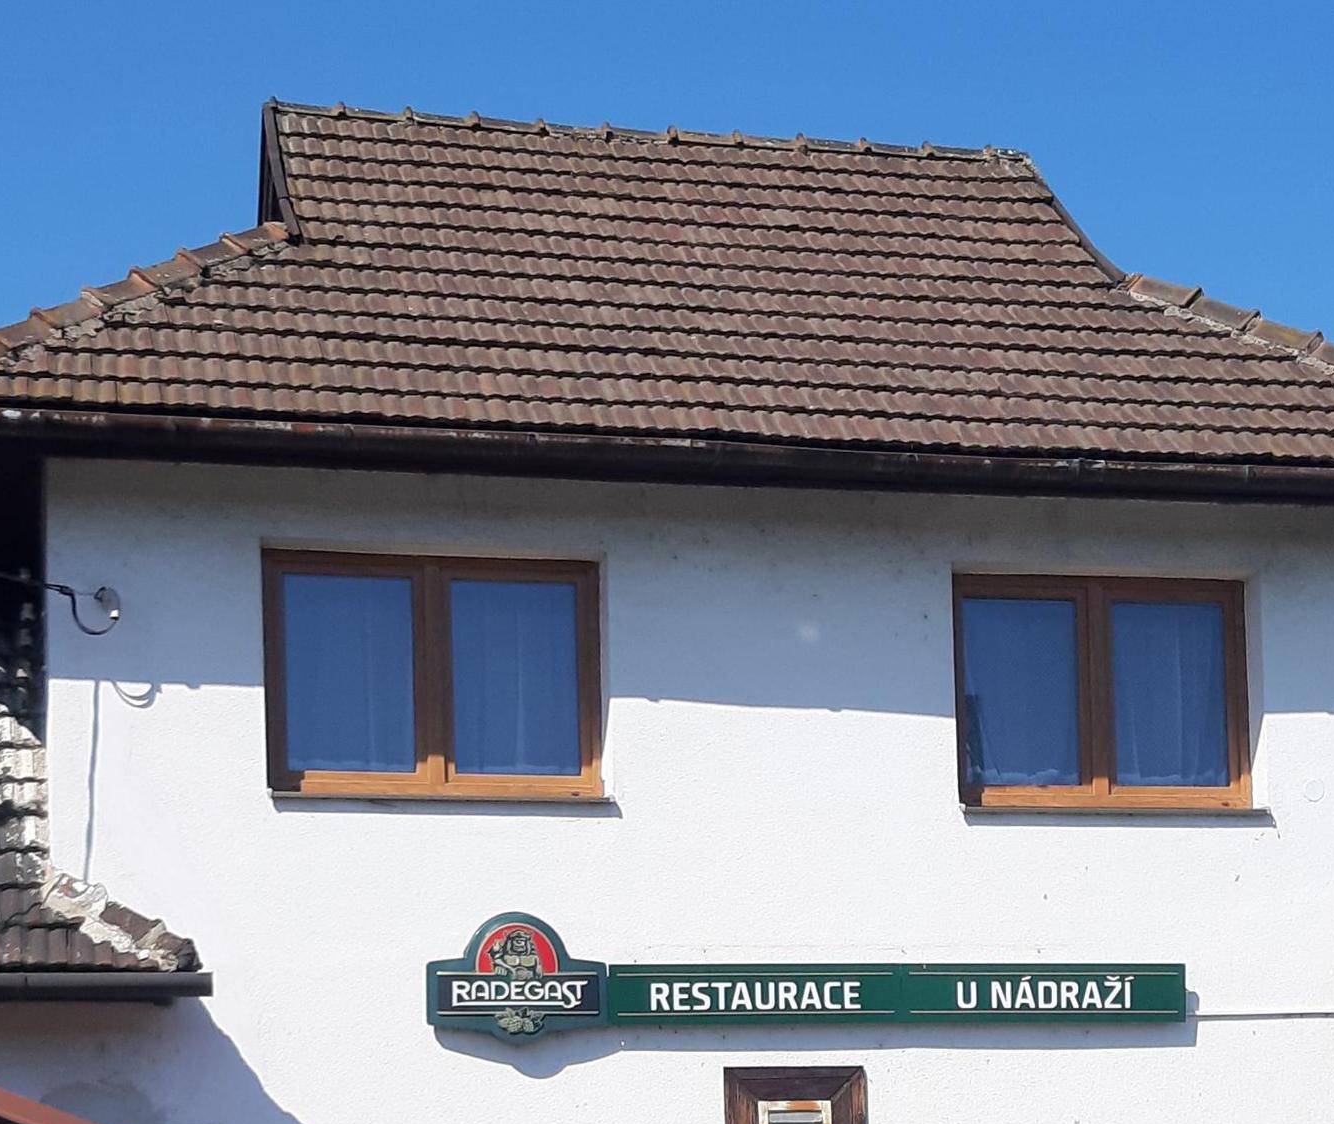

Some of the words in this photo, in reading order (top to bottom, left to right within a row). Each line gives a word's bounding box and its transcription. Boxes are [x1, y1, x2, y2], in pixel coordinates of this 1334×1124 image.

[450, 980, 588, 1009] RADEGAST
[649, 981, 862, 1011] RESTAURACE
[956, 981, 979, 1009] U
[989, 973, 1135, 1010] NÁDRAŽÍ
